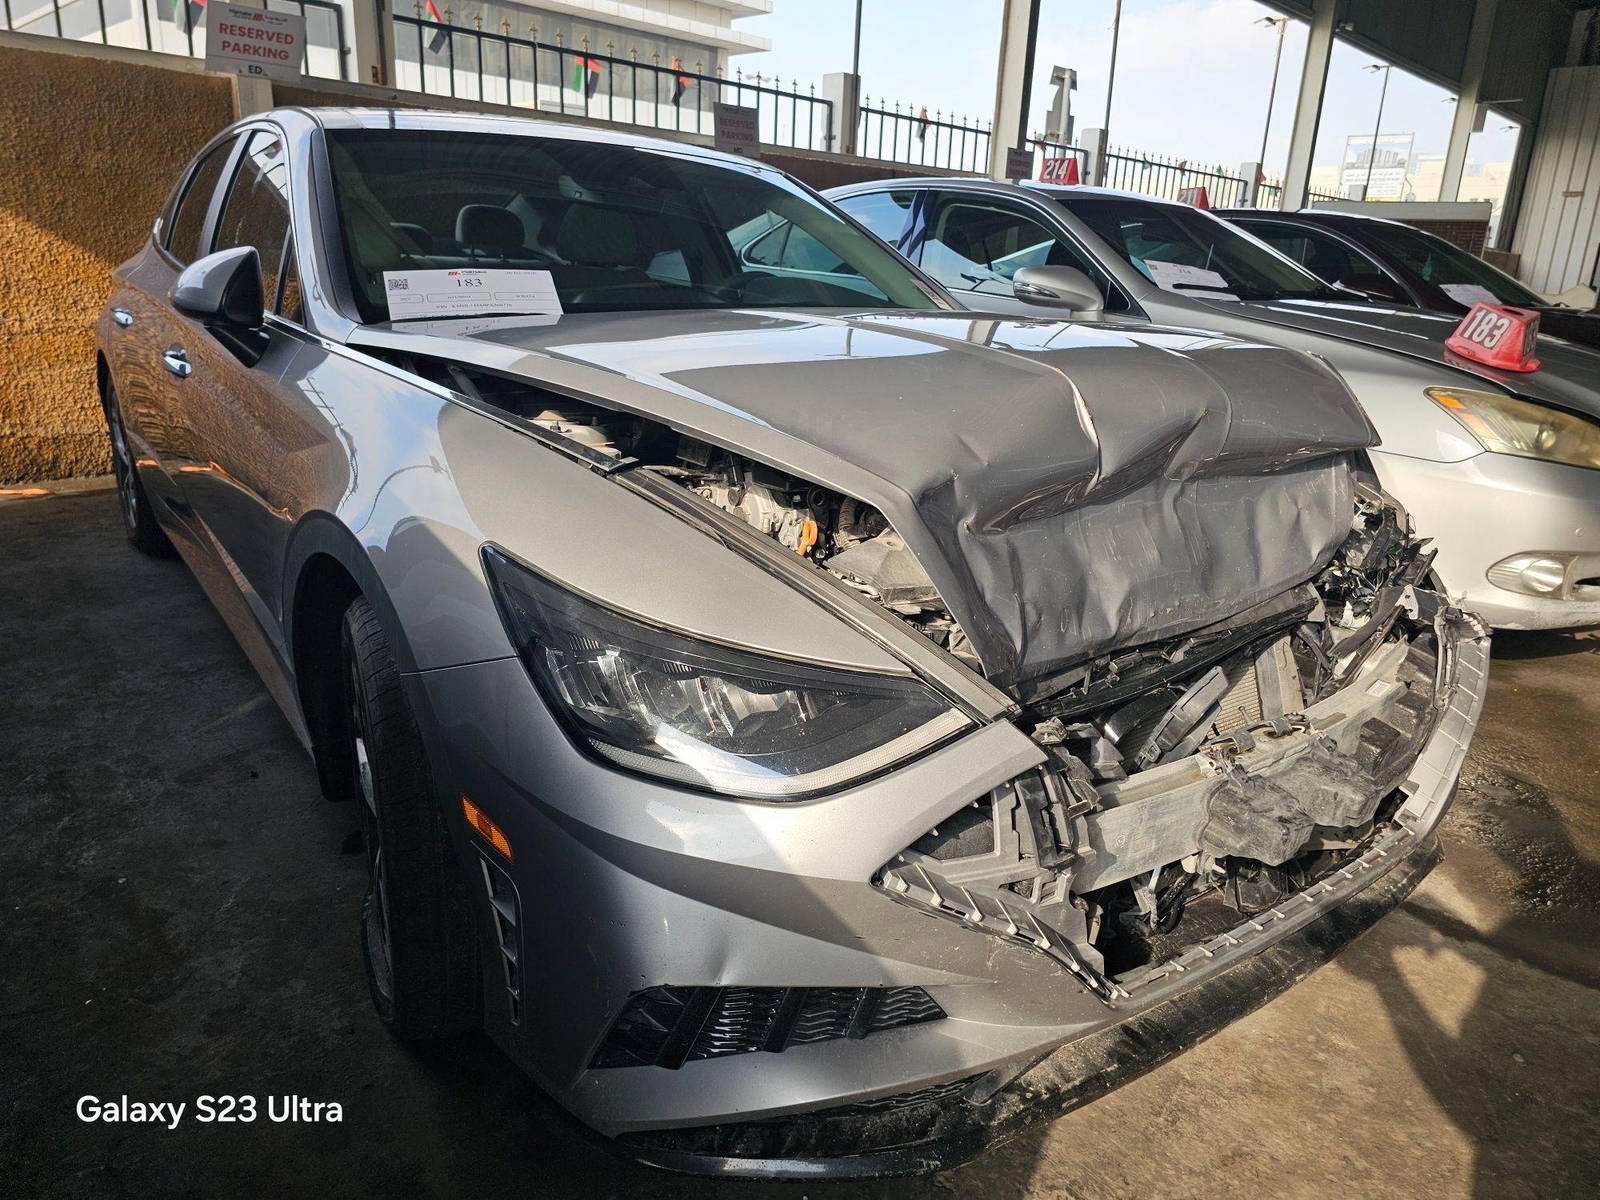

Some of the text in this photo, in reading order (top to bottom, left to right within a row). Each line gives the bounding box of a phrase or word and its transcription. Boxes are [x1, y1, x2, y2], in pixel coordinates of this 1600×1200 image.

[219, 23, 294, 45] RESERVED
[221, 40, 289, 60] PARKING
[1043, 160, 1069, 180] 214
[456, 278, 483, 288] 183
[1463, 309, 1510, 348] 183
